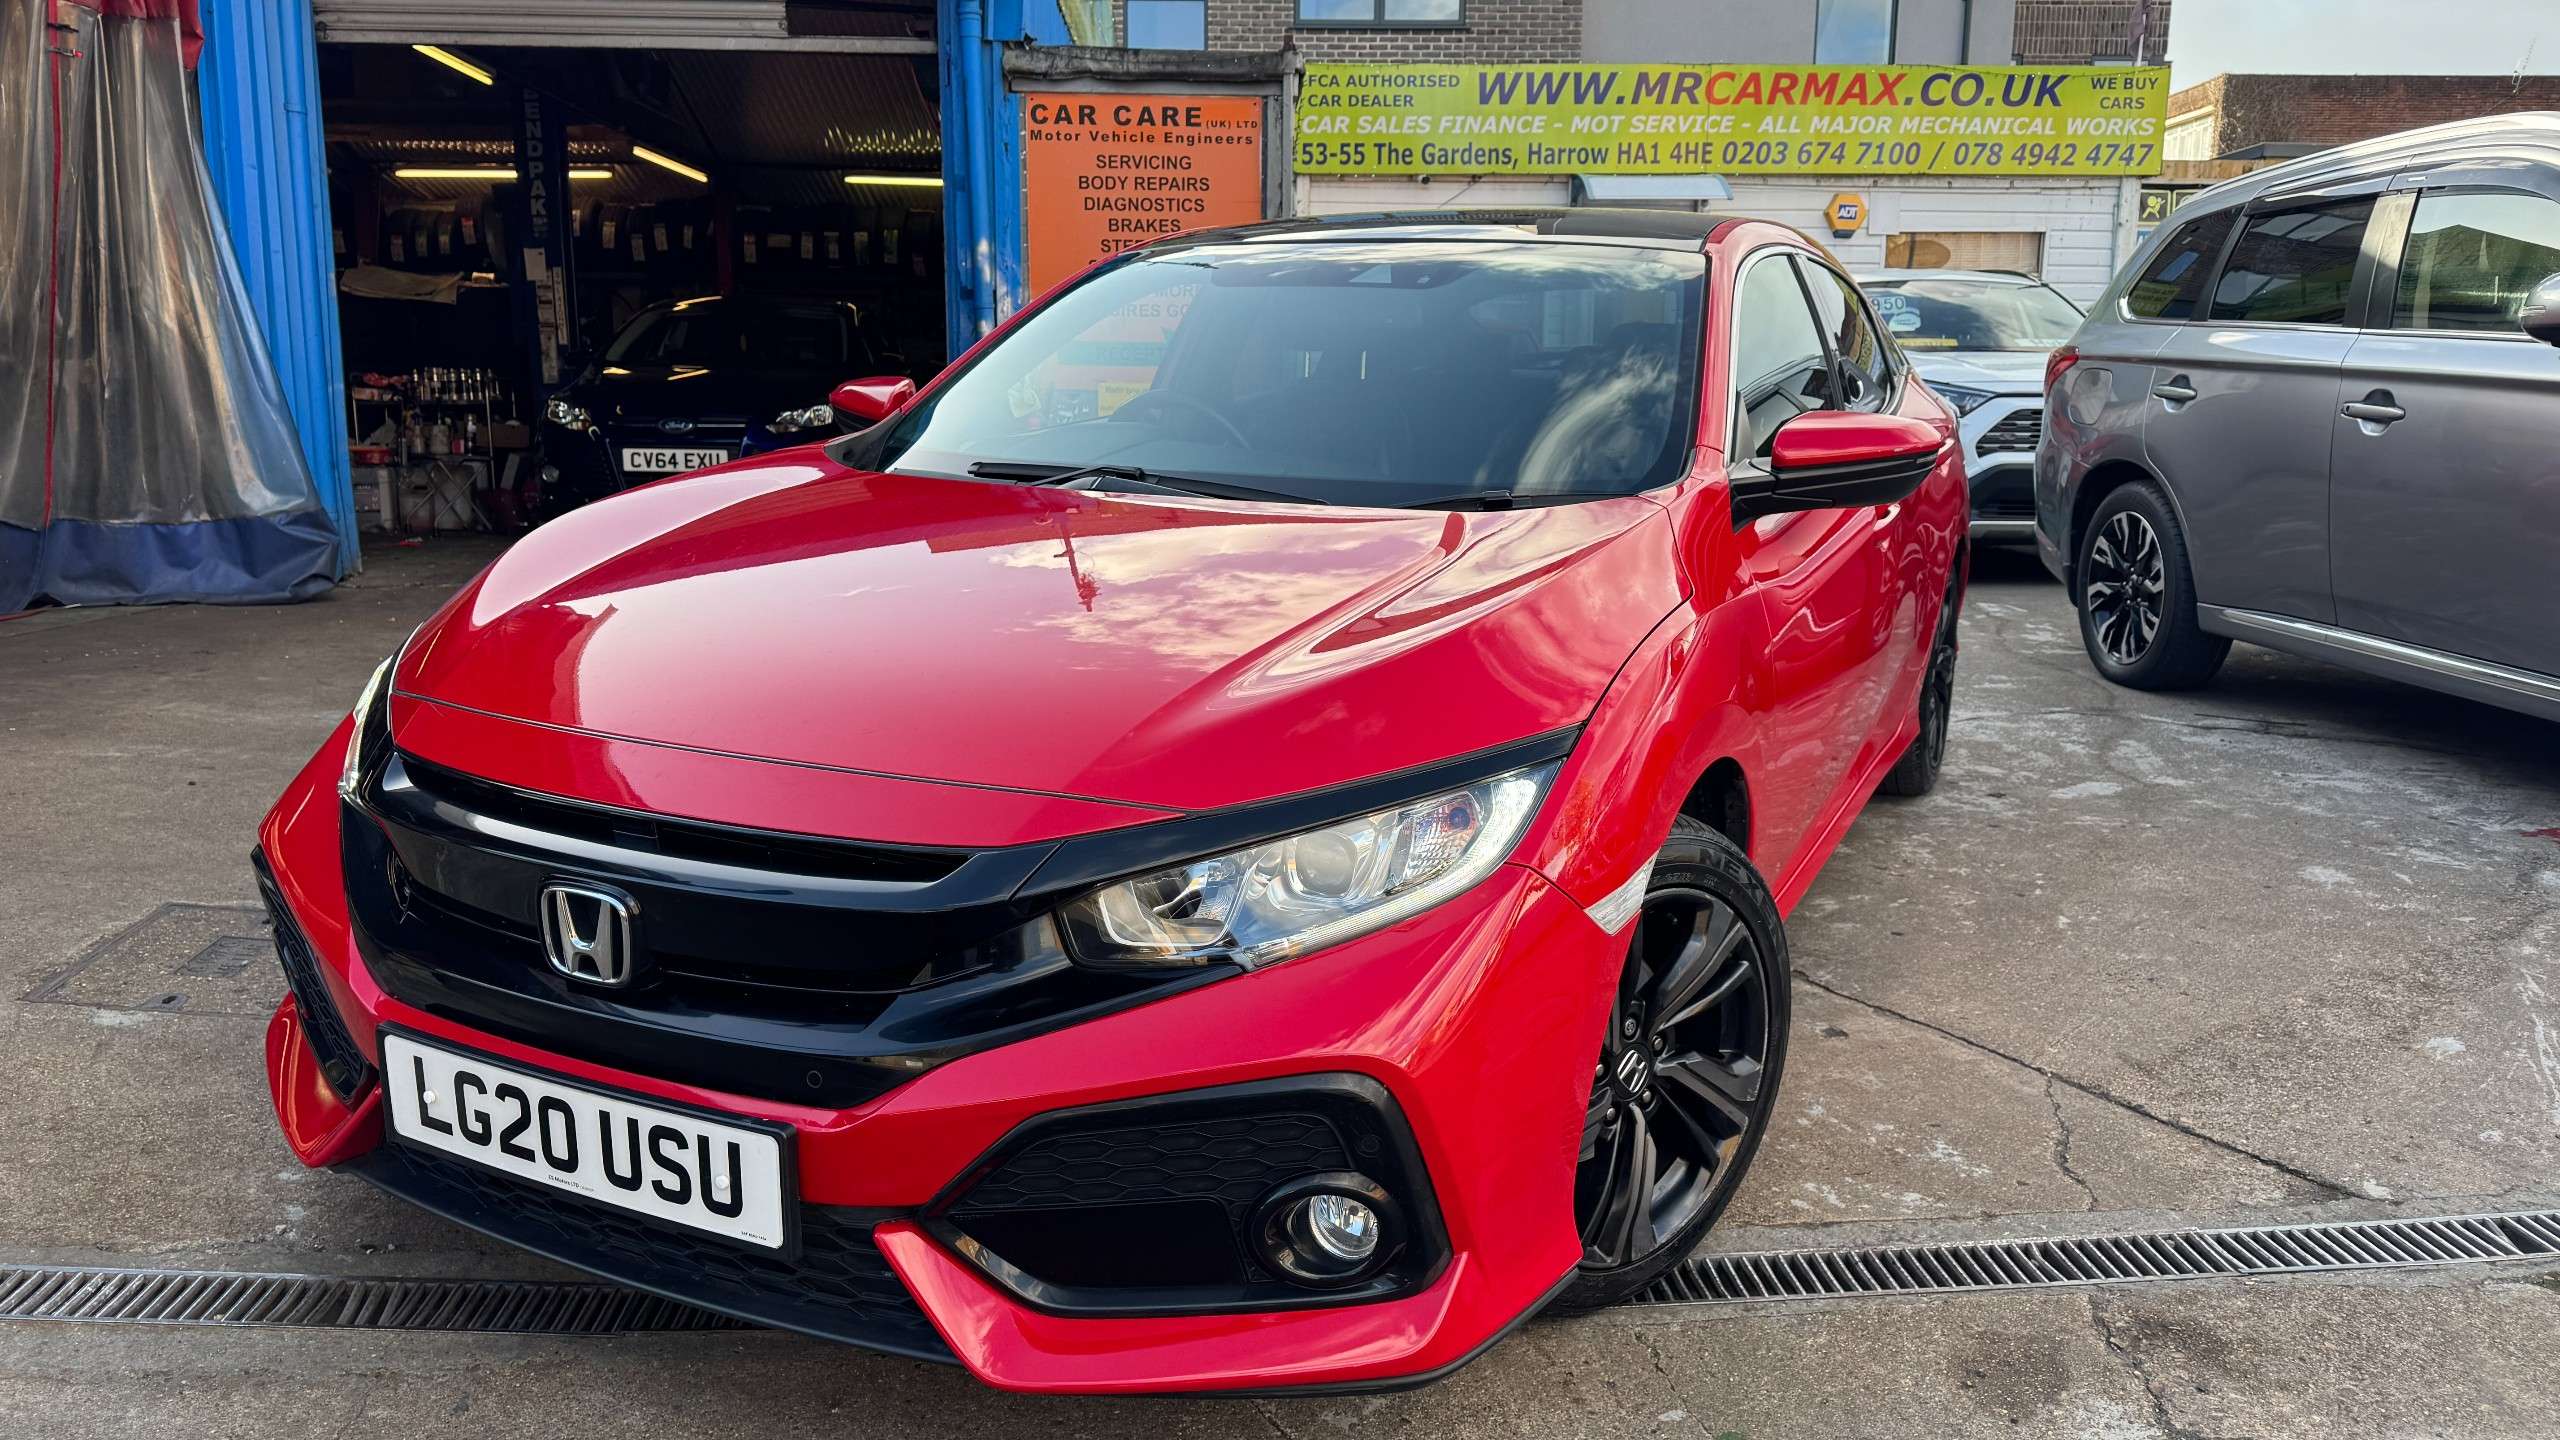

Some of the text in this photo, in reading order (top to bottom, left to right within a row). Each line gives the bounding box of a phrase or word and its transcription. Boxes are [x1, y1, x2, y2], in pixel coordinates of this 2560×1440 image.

[1308, 74, 1460, 89] FCA AUTHORISED
[1478, 72, 2070, 107] WWW.MRCARMAX.CO.UK
[2091, 76, 2159, 91] WE BUY
[1308, 94, 1414, 108] CAR DEALER
[2100, 96, 2145, 110] CARS
[1030, 103, 1258, 129] CAR CARE (UK) LTD
[1302, 115, 1350, 134] CAR
[1356, 115, 1432, 134] SALES
[1438, 115, 1546, 134] FINANCE
[1570, 115, 1624, 134] MOT
[1630, 115, 1734, 134] SERVICE
[1757, 115, 1801, 134] ALL
[1809, 115, 1891, 134] MAJOR
[1899, 116, 2056, 135] MECHANICAL
[2066, 117, 2156, 135] WORKS
[1030, 130, 1254, 146] Motor Vehicle Engineers
[1096, 154, 1192, 170] SERVICING
[1301, 142, 1366, 165] 53-55
[1373, 142, 1413, 165] The
[1422, 142, 1519, 169] Gardens,
[1528, 142, 1610, 165] Harrow
[1617, 142, 1660, 164] HA1
[1670, 142, 1713, 164] 4HE
[1722, 142, 1788, 165] 0203
[1797, 142, 1846, 165] 674
[1855, 142, 1921, 165] 7100
[1953, 142, 2002, 166] 078
[2011, 143, 2077, 166] 4942
[2085, 143, 2154, 166] 4747
[1079, 176, 1210, 192] BODY REPAIRS
[1084, 196, 1205, 213] DIAGNOSTICS
[1838, 205, 1857, 218] ADT
[1108, 218, 1181, 233] BRAKES
[1100, 238, 1151, 253] STE
[630, 452, 721, 469] CV64 EXU
[413, 1055, 744, 1219] LG20 USU
